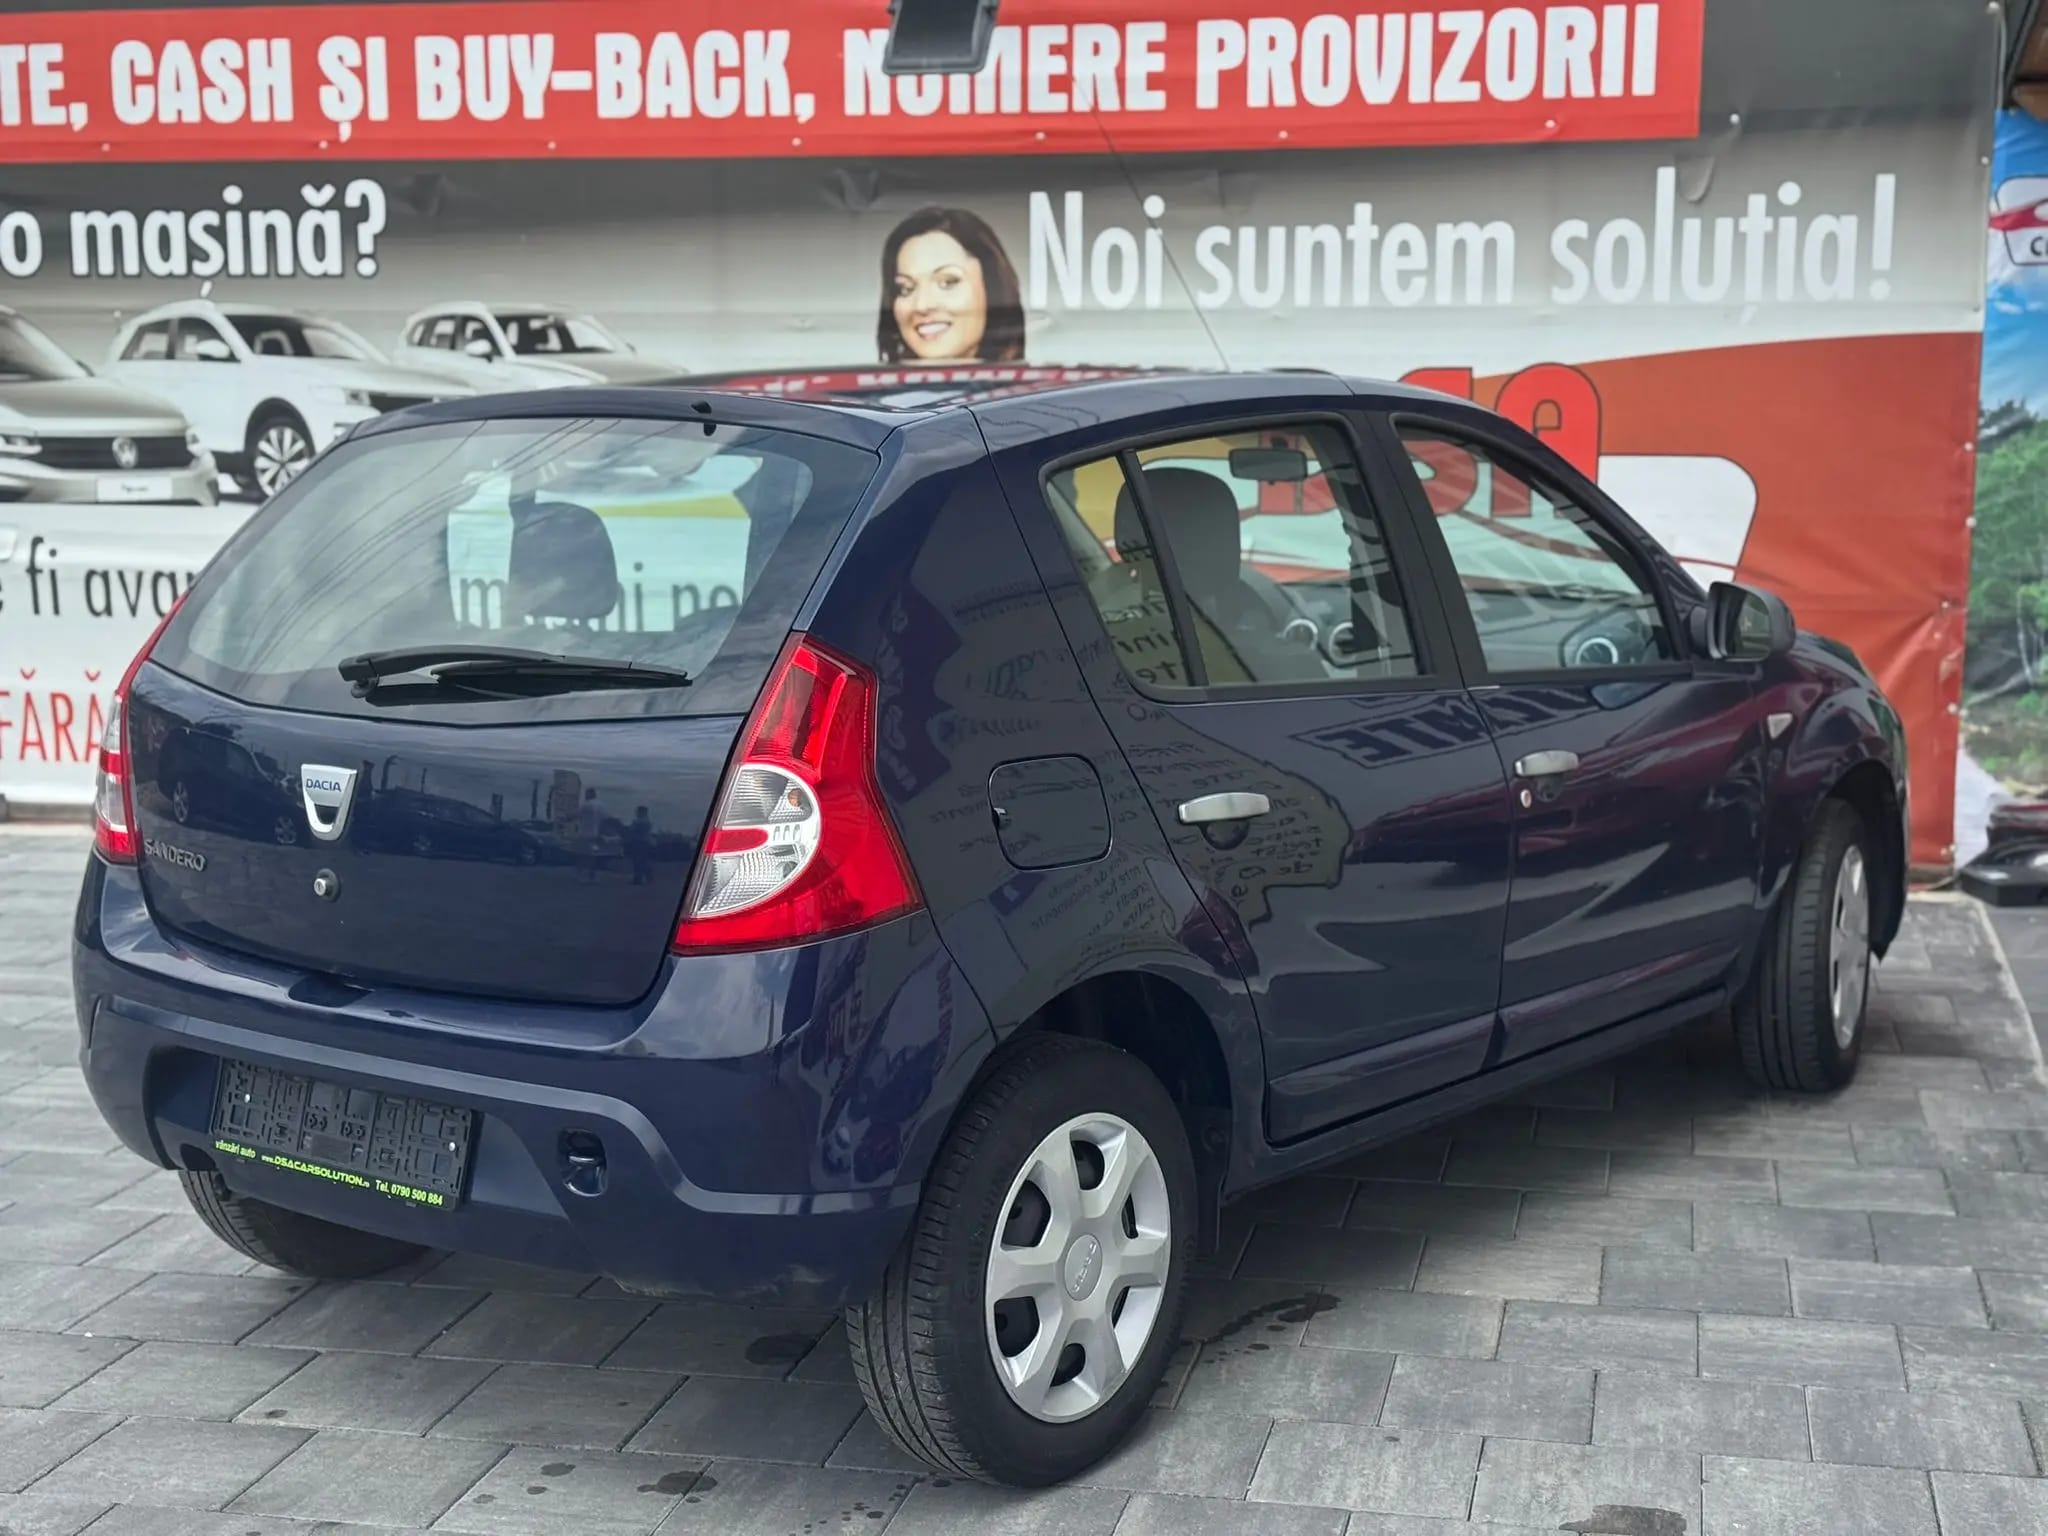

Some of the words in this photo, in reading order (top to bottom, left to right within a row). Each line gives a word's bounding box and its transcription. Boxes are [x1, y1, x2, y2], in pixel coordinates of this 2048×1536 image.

[0, 43, 89, 132] TE,
[110, 37, 294, 125] CASH
[317, 35, 389, 142] ȘI
[414, 29, 815, 124] BUY-BACK,
[1196, 3, 1659, 110] PROVIZORII
[0, 211, 43, 277] o
[70, 178, 386, 298] mașină?
[1029, 191, 1166, 310] Noi
[1194, 202, 1516, 308] suntem
[1550, 166, 1896, 325] soluția!
[26, 536, 60, 615] fi
[84, 568, 196, 618] ava
[305, 777, 342, 793] DACIA
[143, 838, 206, 872] SANDERO
[240, 1146, 257, 1159] auto
[261, 1154, 370, 1188] www.DSACARSOLUTION.ro
[375, 1179, 390, 1194] Tel.
[390, 1183, 411, 1198] 0790
[411, 1188, 427, 1202] 500
[427, 1192, 443, 1206] 884
